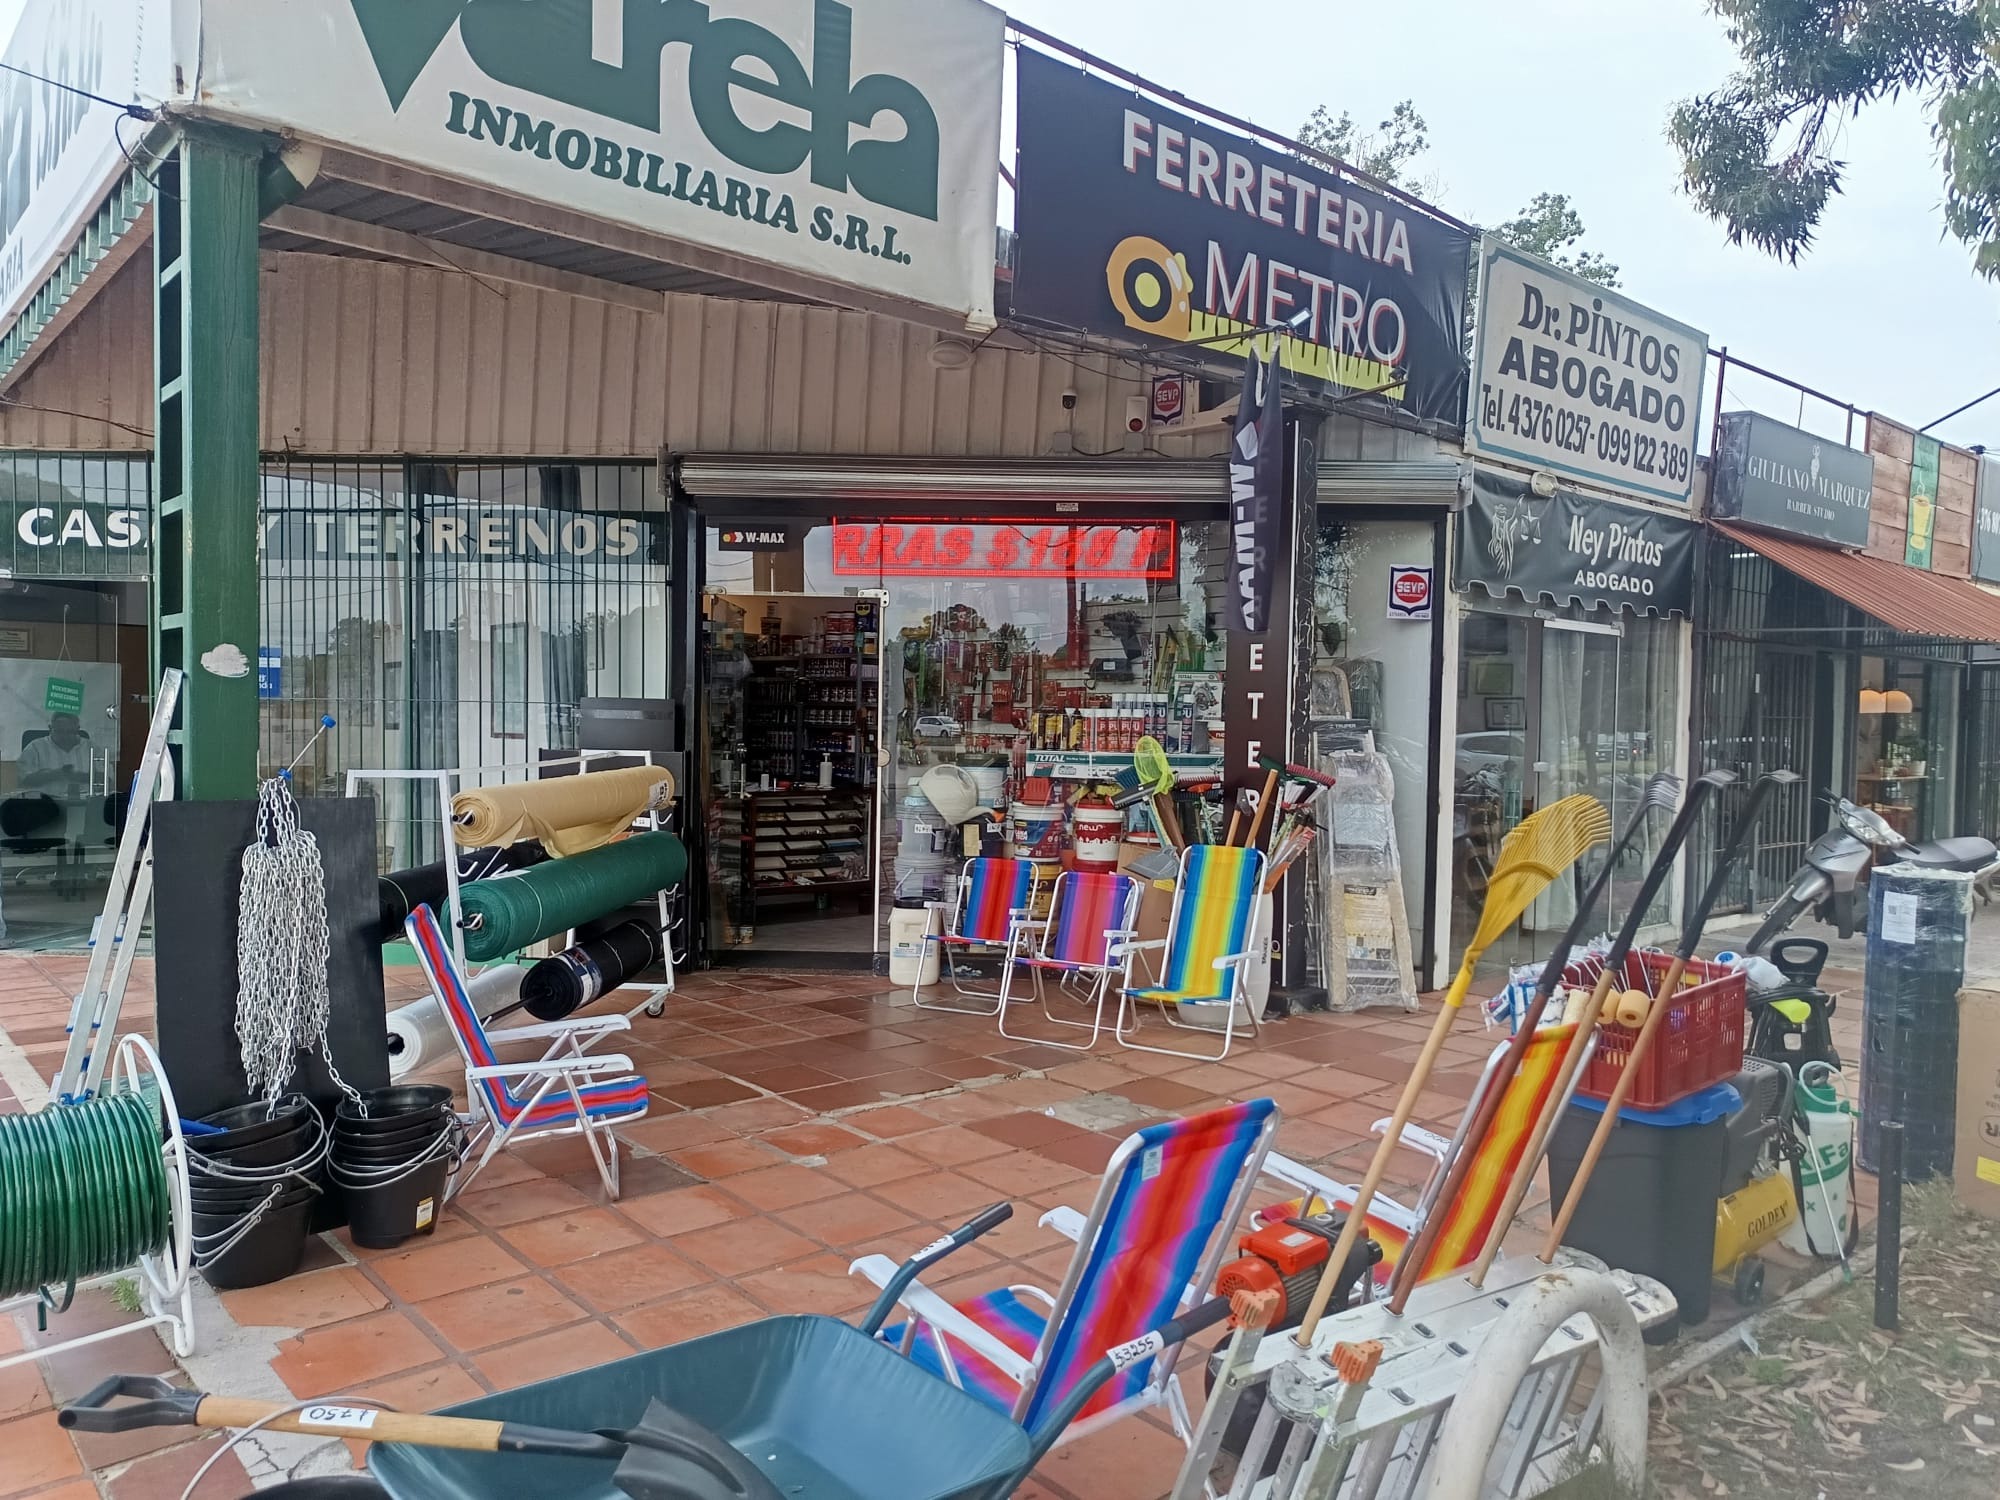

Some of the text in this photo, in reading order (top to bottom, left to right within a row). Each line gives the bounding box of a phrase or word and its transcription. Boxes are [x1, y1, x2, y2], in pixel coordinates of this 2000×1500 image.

[445, 91, 913, 266] INMOBILIARIA S.R.L.
[1122, 108, 1414, 274] FERRETERIA
[1205, 239, 1406, 364] METRO
[1498, 336, 1685, 431] ABOGADO
[1482, 383, 1505, 432] Tel.
[1508, 393, 1554, 444] 4376
[1633, 432, 1656, 474] 122
[1659, 440, 1688, 483] 389
[1748, 455, 1871, 511] GIULIANO MARQUEZ
[1786, 498, 1835, 521] BARBER STUDIO
[18, 507, 156, 548] CAS
[306, 515, 640, 556] TERRENOS
[746, 532, 785, 543] W-MAX
[1568, 515, 1664, 568] Ney Pintos
[1396, 581, 1425, 594] SEVP
[1574, 569, 1654, 596] ABOGADO
[1035, 754, 1066, 763] TOTAL
